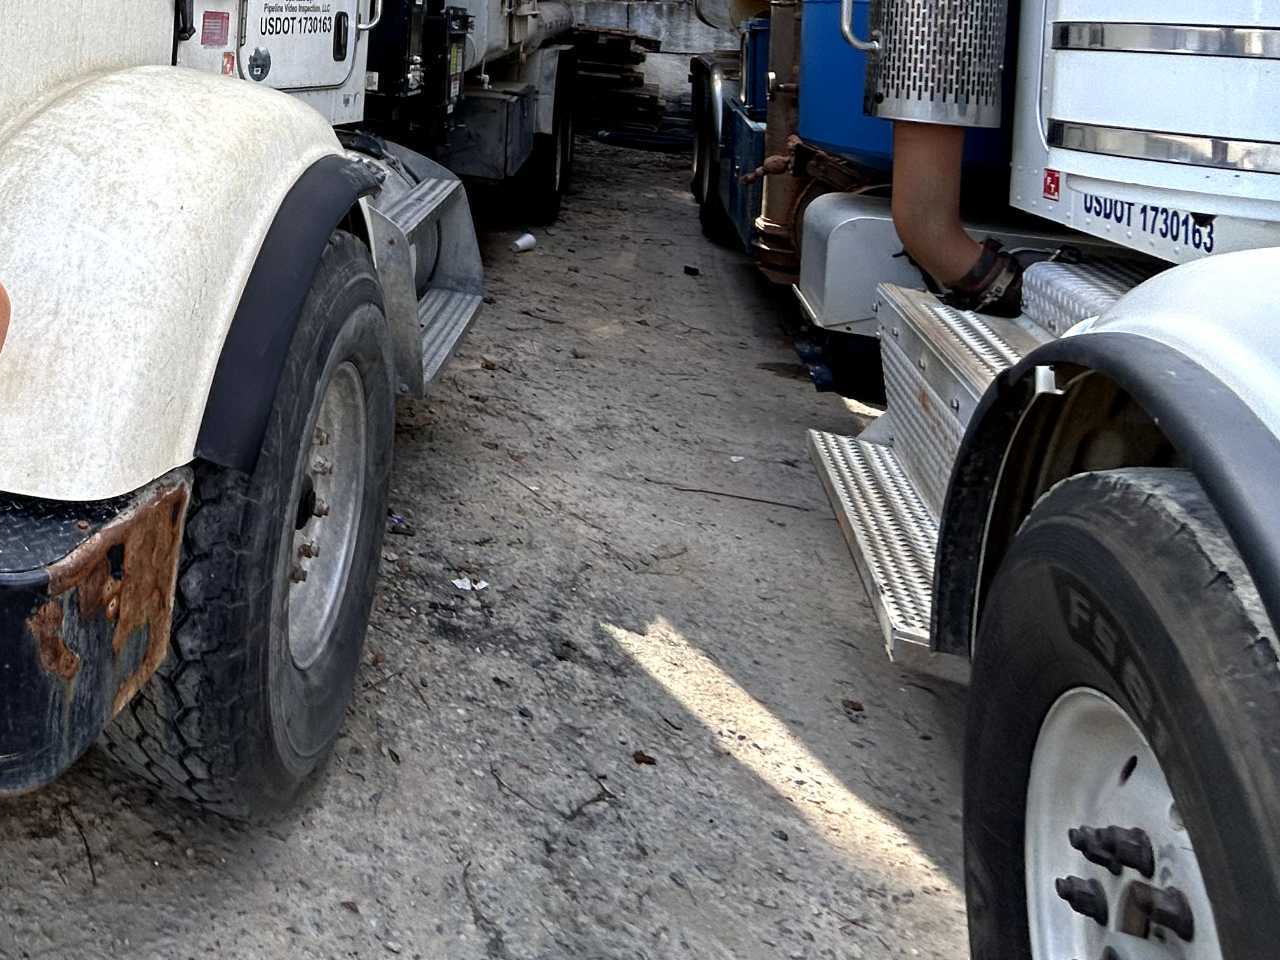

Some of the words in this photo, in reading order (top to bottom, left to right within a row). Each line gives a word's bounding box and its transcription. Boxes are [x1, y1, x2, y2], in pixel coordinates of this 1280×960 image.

[263, 3, 284, 15] Pipeline
[285, 3, 298, 13] Video
[322, 3, 331, 13] LLC
[260, 16, 297, 36] USDOT
[298, 16, 332, 35] 1730163
[1084, 193, 1135, 227] USDOT
[1140, 204, 1214, 253] 1730163
